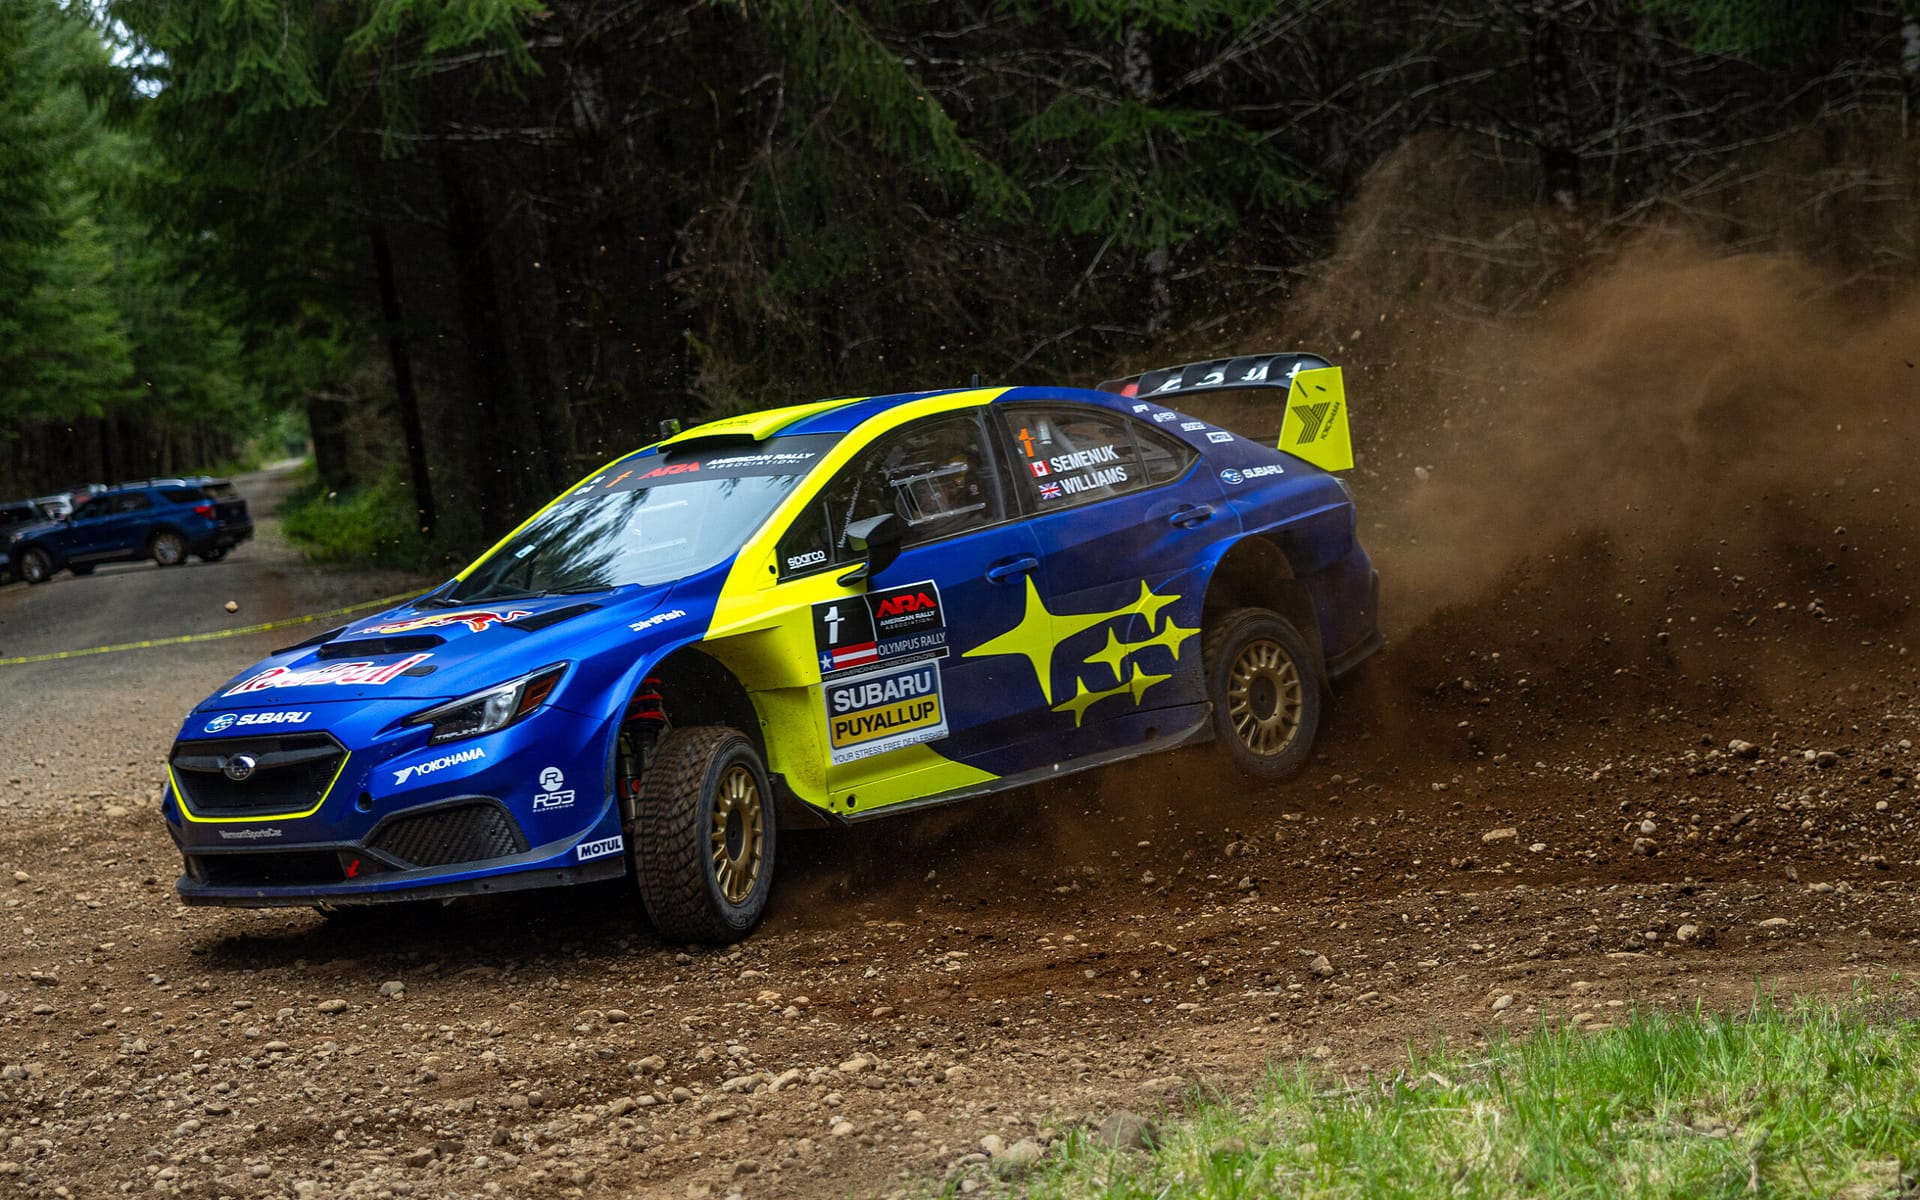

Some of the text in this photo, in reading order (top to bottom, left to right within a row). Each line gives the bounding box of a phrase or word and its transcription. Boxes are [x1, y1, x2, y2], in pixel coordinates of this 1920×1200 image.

[706, 452, 816, 466] AMERICAN RALLY
[1050, 444, 1120, 473] SEMENUK
[638, 461, 700, 480] ARA
[1060, 466, 1128, 495] WILLIAMS
[1241, 464, 1285, 479] SUBARU
[787, 550, 827, 570] sparco
[875, 591, 937, 619] ARA
[823, 606, 846, 645] 1
[880, 610, 936, 627] AMERICAN RALLY
[878, 631, 946, 656] OLYMPUS RALLY
[833, 671, 932, 713] SUBARU
[236, 711, 312, 726] SUBARU
[835, 701, 935, 740] PUYALLUP
[413, 747, 486, 776] YOKOHAMA
[833, 752, 854, 764] YOUR
[855, 745, 883, 759] STRESS
[883, 741, 903, 753] FREE
[532, 790, 576, 809] R53
[581, 838, 621, 858] MOTUL
